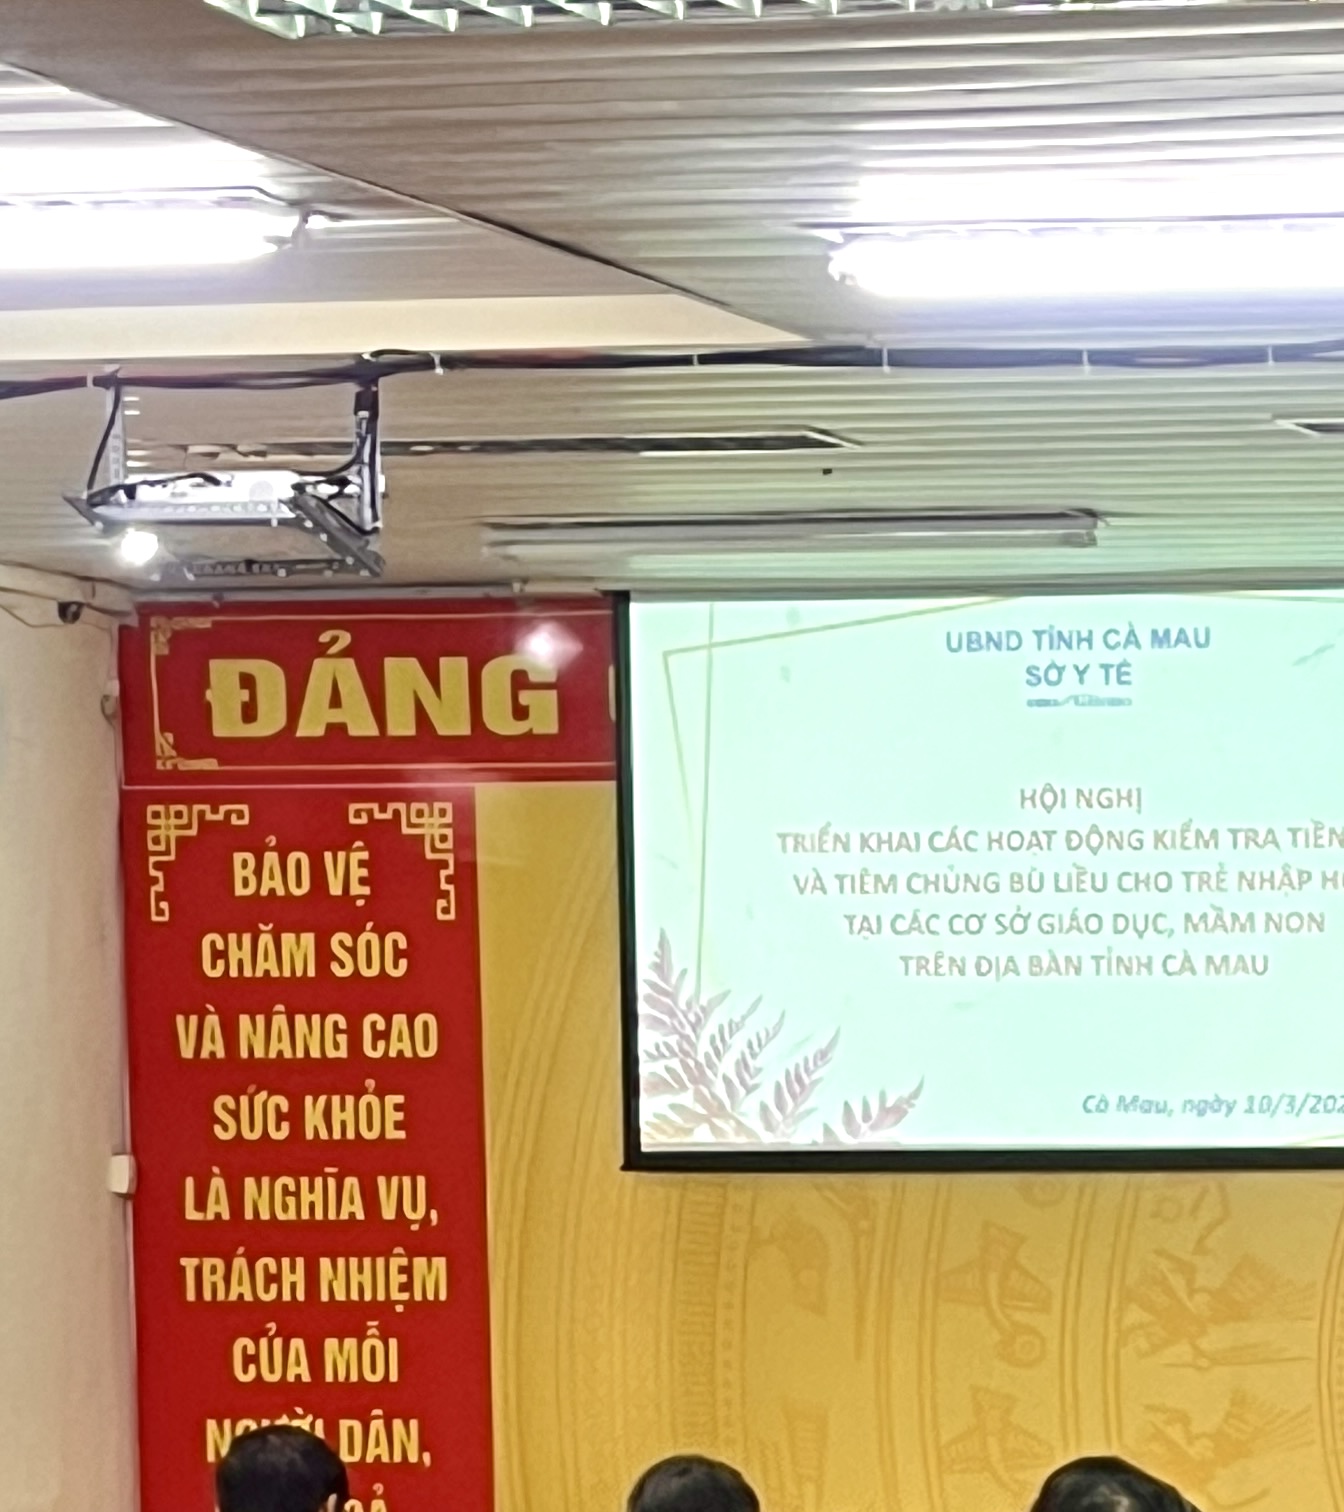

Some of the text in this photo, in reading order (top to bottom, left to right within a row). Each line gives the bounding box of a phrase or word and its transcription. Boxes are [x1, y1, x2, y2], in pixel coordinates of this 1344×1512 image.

[946, 620, 1211, 653] UBND TỈNH CÀ MAU
[205, 629, 560, 738] ĐẢNG
[1025, 659, 1066, 687] SỞ
[1072, 663, 1091, 685] Y
[1020, 782, 1142, 814] HỘI NGHỊ
[776, 821, 850, 853] TRIỂN
[860, 831, 920, 852] KHAI
[928, 825, 979, 852] CÁC
[987, 829, 1057, 857] HOẠT
[1065, 823, 1144, 856] ĐỘNG
[1153, 818, 1219, 850] KIỂM
[1227, 827, 1281, 852] TRA
[232, 836, 371, 907] BẢO VỆ
[793, 867, 828, 895] VÀ
[834, 867, 898, 894] TIÊM
[1054, 862, 1108, 893] LIỀU
[1117, 871, 1173, 892] CHO
[1181, 861, 1229, 892] TRẺ
[1237, 862, 1312, 898] NHẬP
[201, 921, 408, 978] CHĂM SÓC
[843, 903, 1325, 940] TẠI CÁC CƠ SỞ GIÁO DỤC, MẦM NON
[899, 945, 1269, 983] TRÊN ĐỊA BÀN TỈNH CÀ MAU
[176, 1003, 438, 1059] VÀ NÂNG CAO
[213, 1079, 407, 1141] SỨC KHỎE
[1082, 1094, 1110, 1114] Cà
[1116, 1094, 1174, 1117] Mau,
[1181, 1093, 1237, 1118] ngày
[184, 1166, 439, 1231] LÀ NGHĨA VỤ,
[180, 1246, 447, 1312] TRÁCH NHIỆM
[232, 1319, 399, 1384] CỦA MỖI
[339, 1408, 431, 1468] DÂN,
